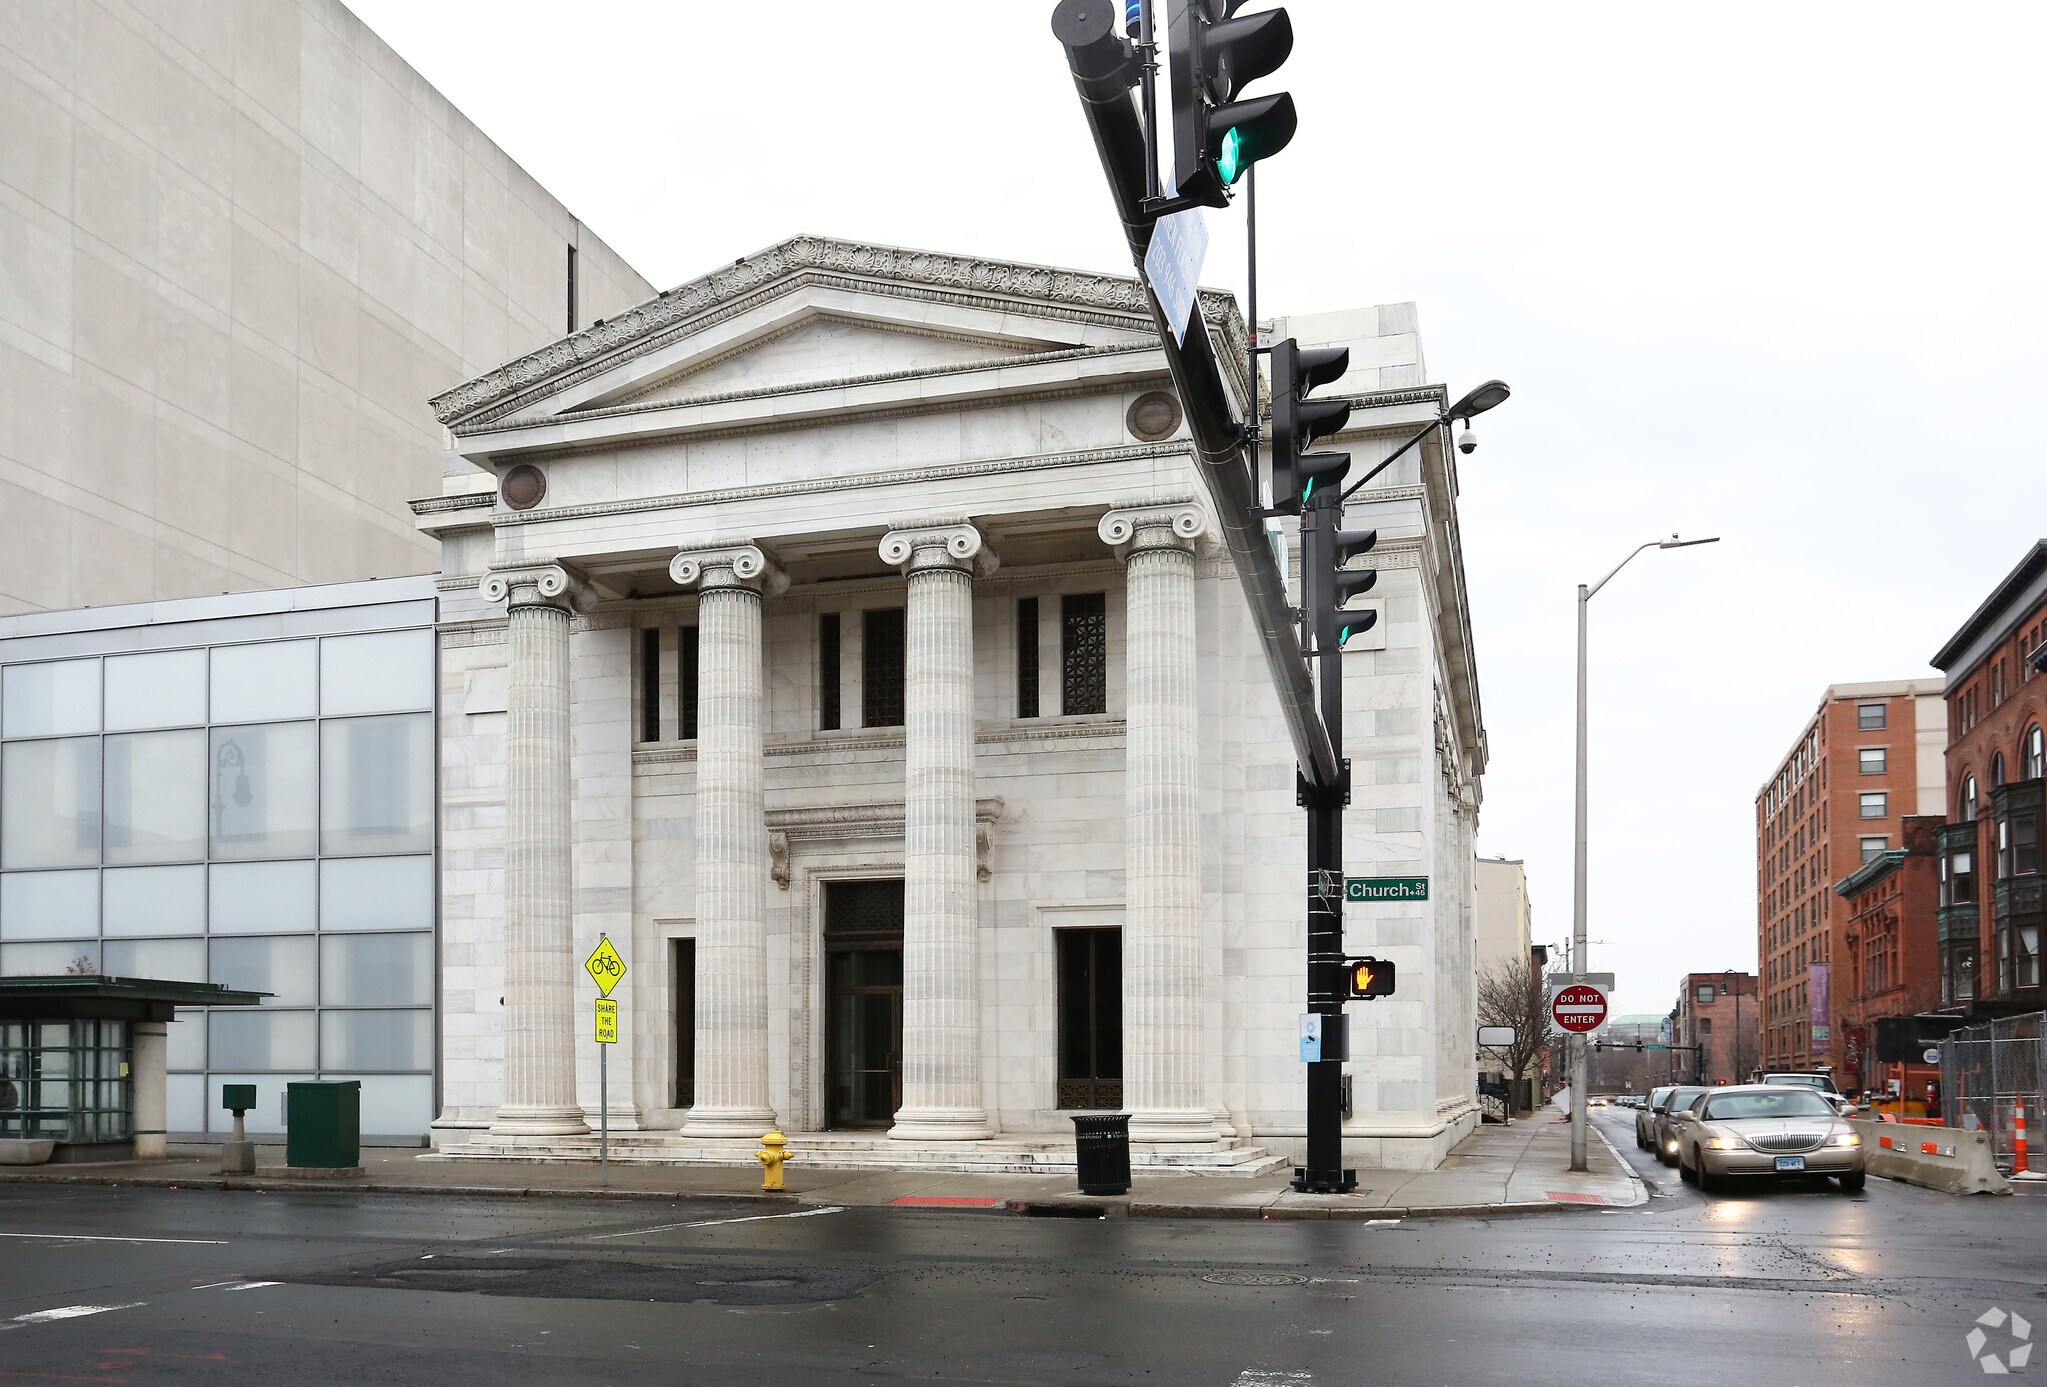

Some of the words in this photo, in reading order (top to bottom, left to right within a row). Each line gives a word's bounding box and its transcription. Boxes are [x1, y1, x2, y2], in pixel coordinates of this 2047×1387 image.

[1151, 236, 1167, 275] 203
[1164, 262, 1176, 299] 946
[1349, 883, 1409, 897] Church
[1415, 882, 1426, 890] St
[1560, 994, 1574, 1003] DO
[1579, 994, 1600, 1003] NOT
[597, 1003, 616, 1014] SHARE
[601, 1016, 612, 1026] THE
[1563, 1015, 1595, 1024] ENTER
[598, 1028, 615, 1039] ROAD
